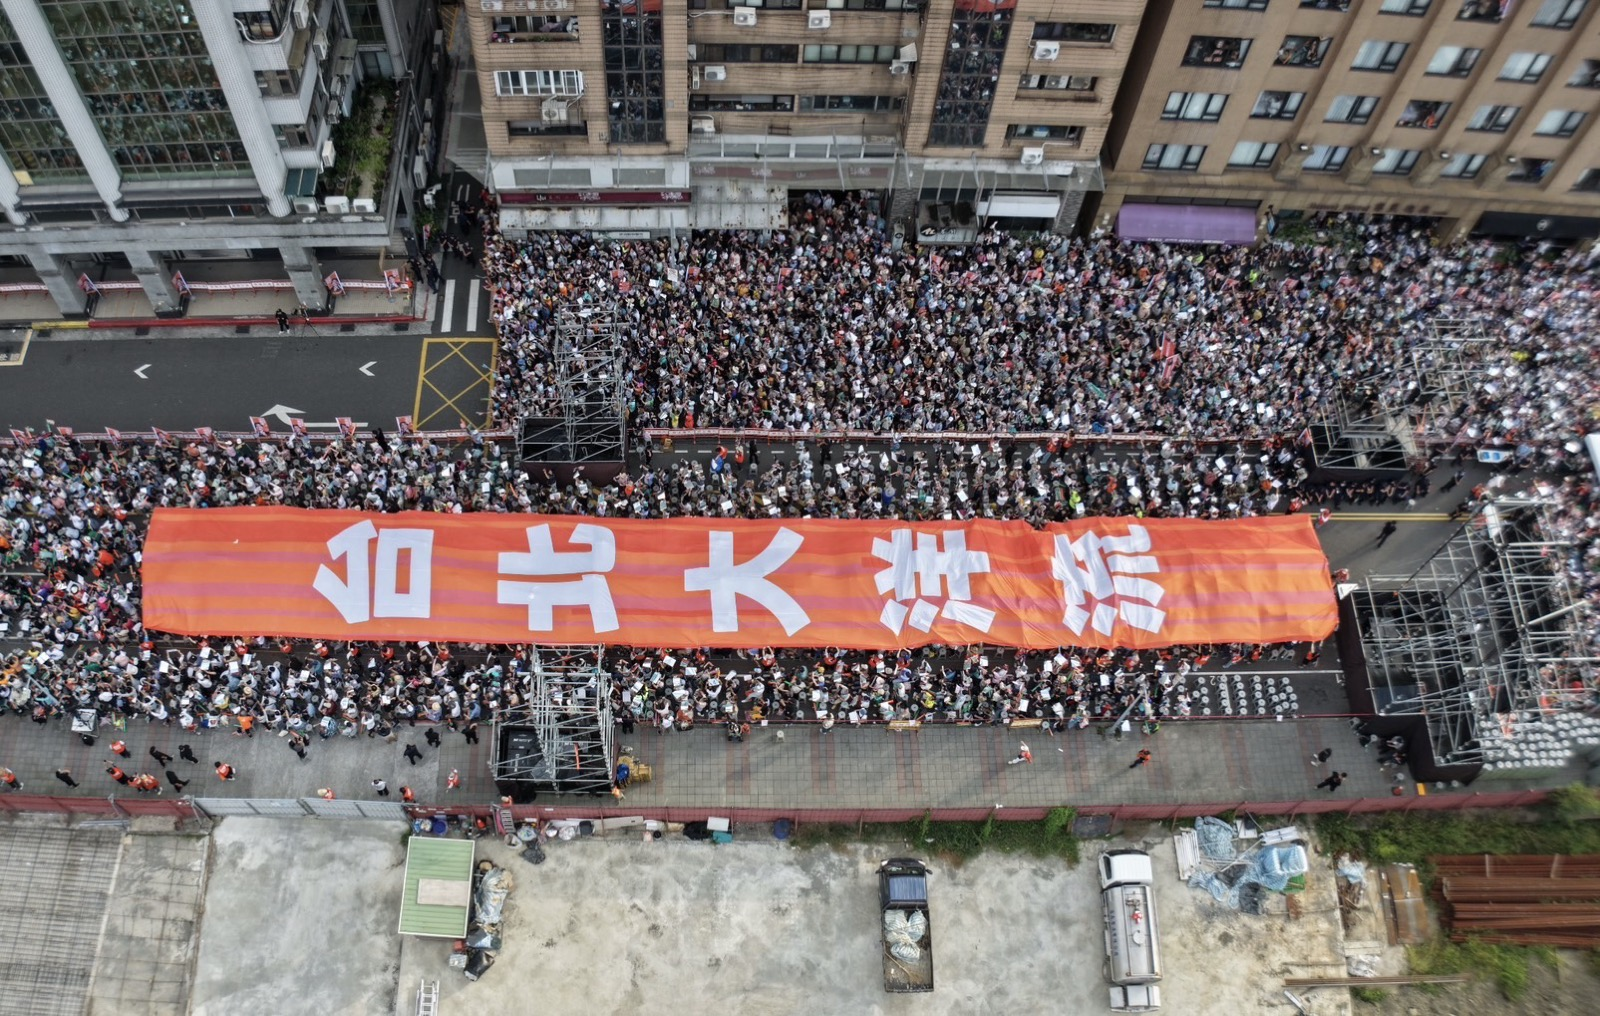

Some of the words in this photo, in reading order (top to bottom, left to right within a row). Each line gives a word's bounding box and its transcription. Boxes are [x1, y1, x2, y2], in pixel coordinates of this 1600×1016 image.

[312, 519, 1167, 637] 台北大洋流
